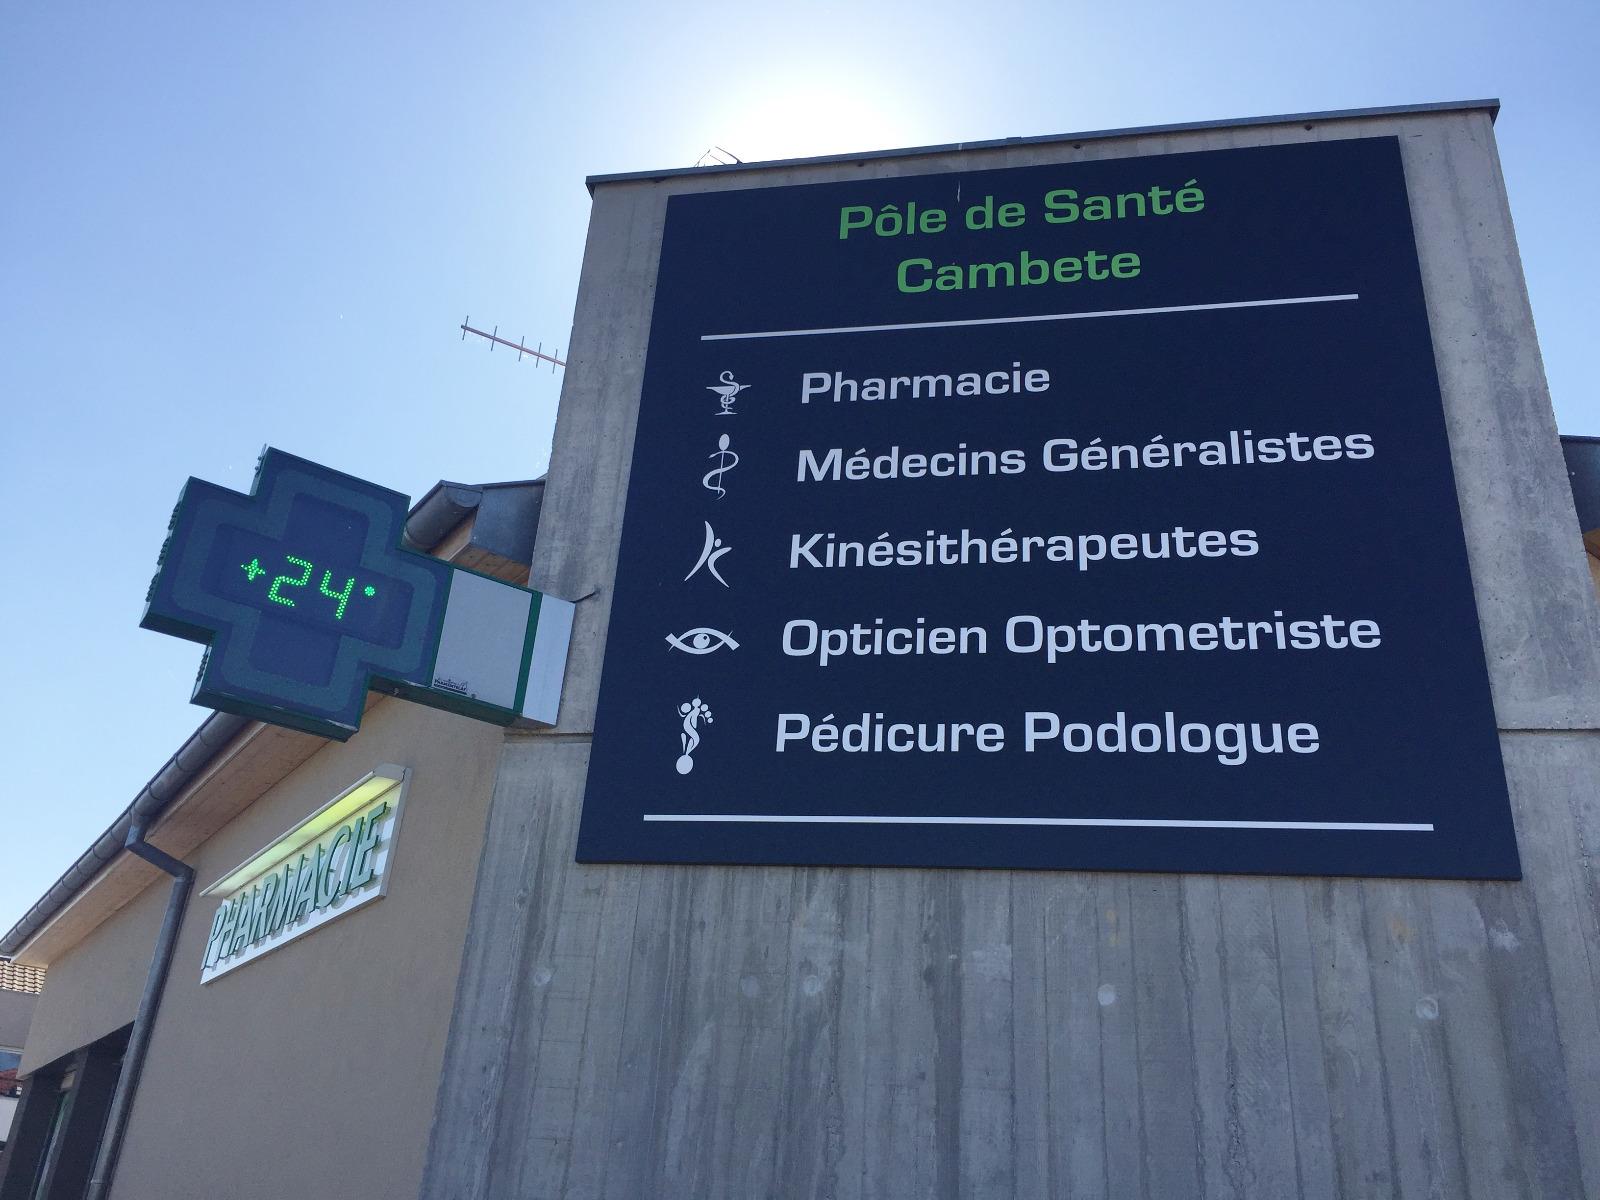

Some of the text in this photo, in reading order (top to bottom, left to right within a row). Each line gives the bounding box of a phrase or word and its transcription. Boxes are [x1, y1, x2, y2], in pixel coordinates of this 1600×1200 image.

[839, 179, 1205, 240] Pôle de Santé
[898, 251, 1140, 293] Cambete
[801, 362, 1050, 404] Pharmacie
[797, 430, 1375, 482] Médecins Généralistes
[790, 527, 1259, 570] Kinésithérapeutes
[782, 611, 1381, 667] Opticien Optometriste
[776, 711, 1320, 766] Pédicure Podologue
[201, 801, 388, 970] PHARMACIE
